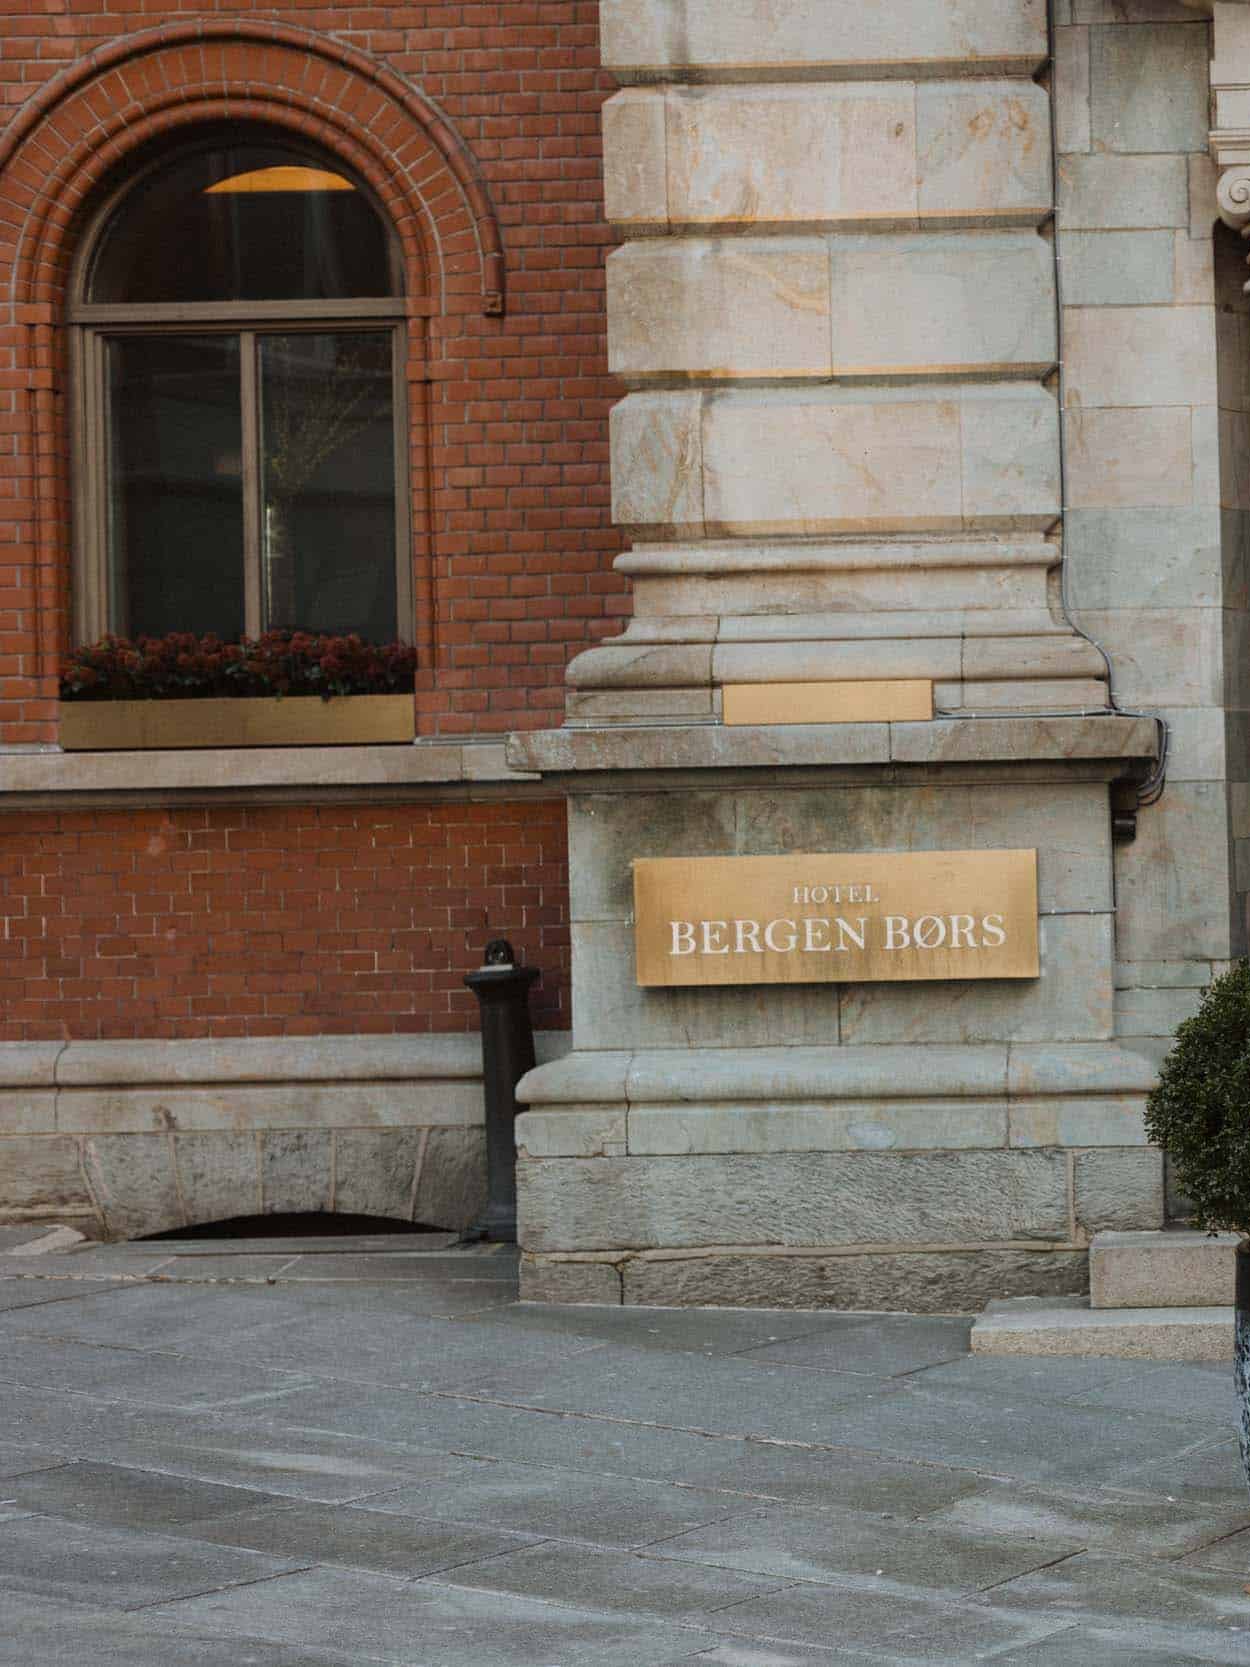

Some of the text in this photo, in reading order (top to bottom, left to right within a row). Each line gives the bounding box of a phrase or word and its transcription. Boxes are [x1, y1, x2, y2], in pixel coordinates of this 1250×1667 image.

[792, 884, 879, 904] HOTEL
[669, 913, 1007, 955] BERGEN BØRS
